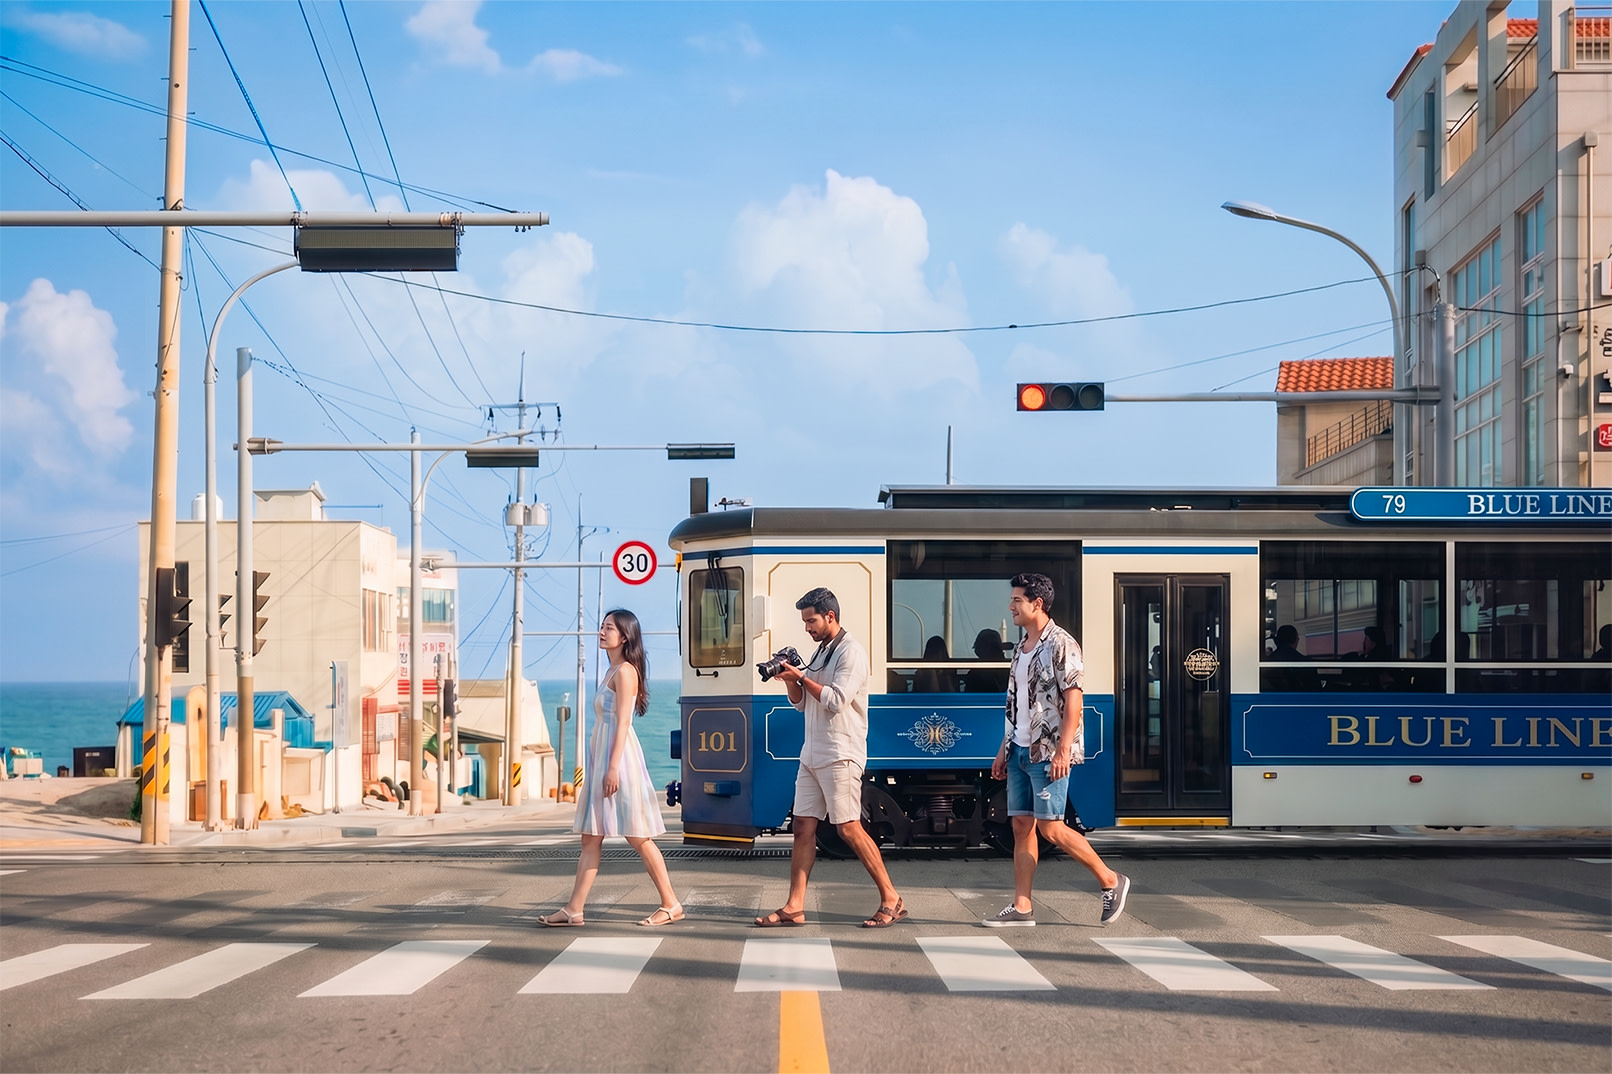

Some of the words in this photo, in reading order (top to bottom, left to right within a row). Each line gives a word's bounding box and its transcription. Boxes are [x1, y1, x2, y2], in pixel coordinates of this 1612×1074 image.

[1382, 494, 1406, 514] 79
[1467, 494, 1541, 515] BLUE
[1549, 494, 1612, 515] LINE
[621, 553, 649, 573] 30
[698, 730, 738, 753] 101
[1327, 715, 1472, 748] BLUE
[1490, 716, 1612, 748] LINE
